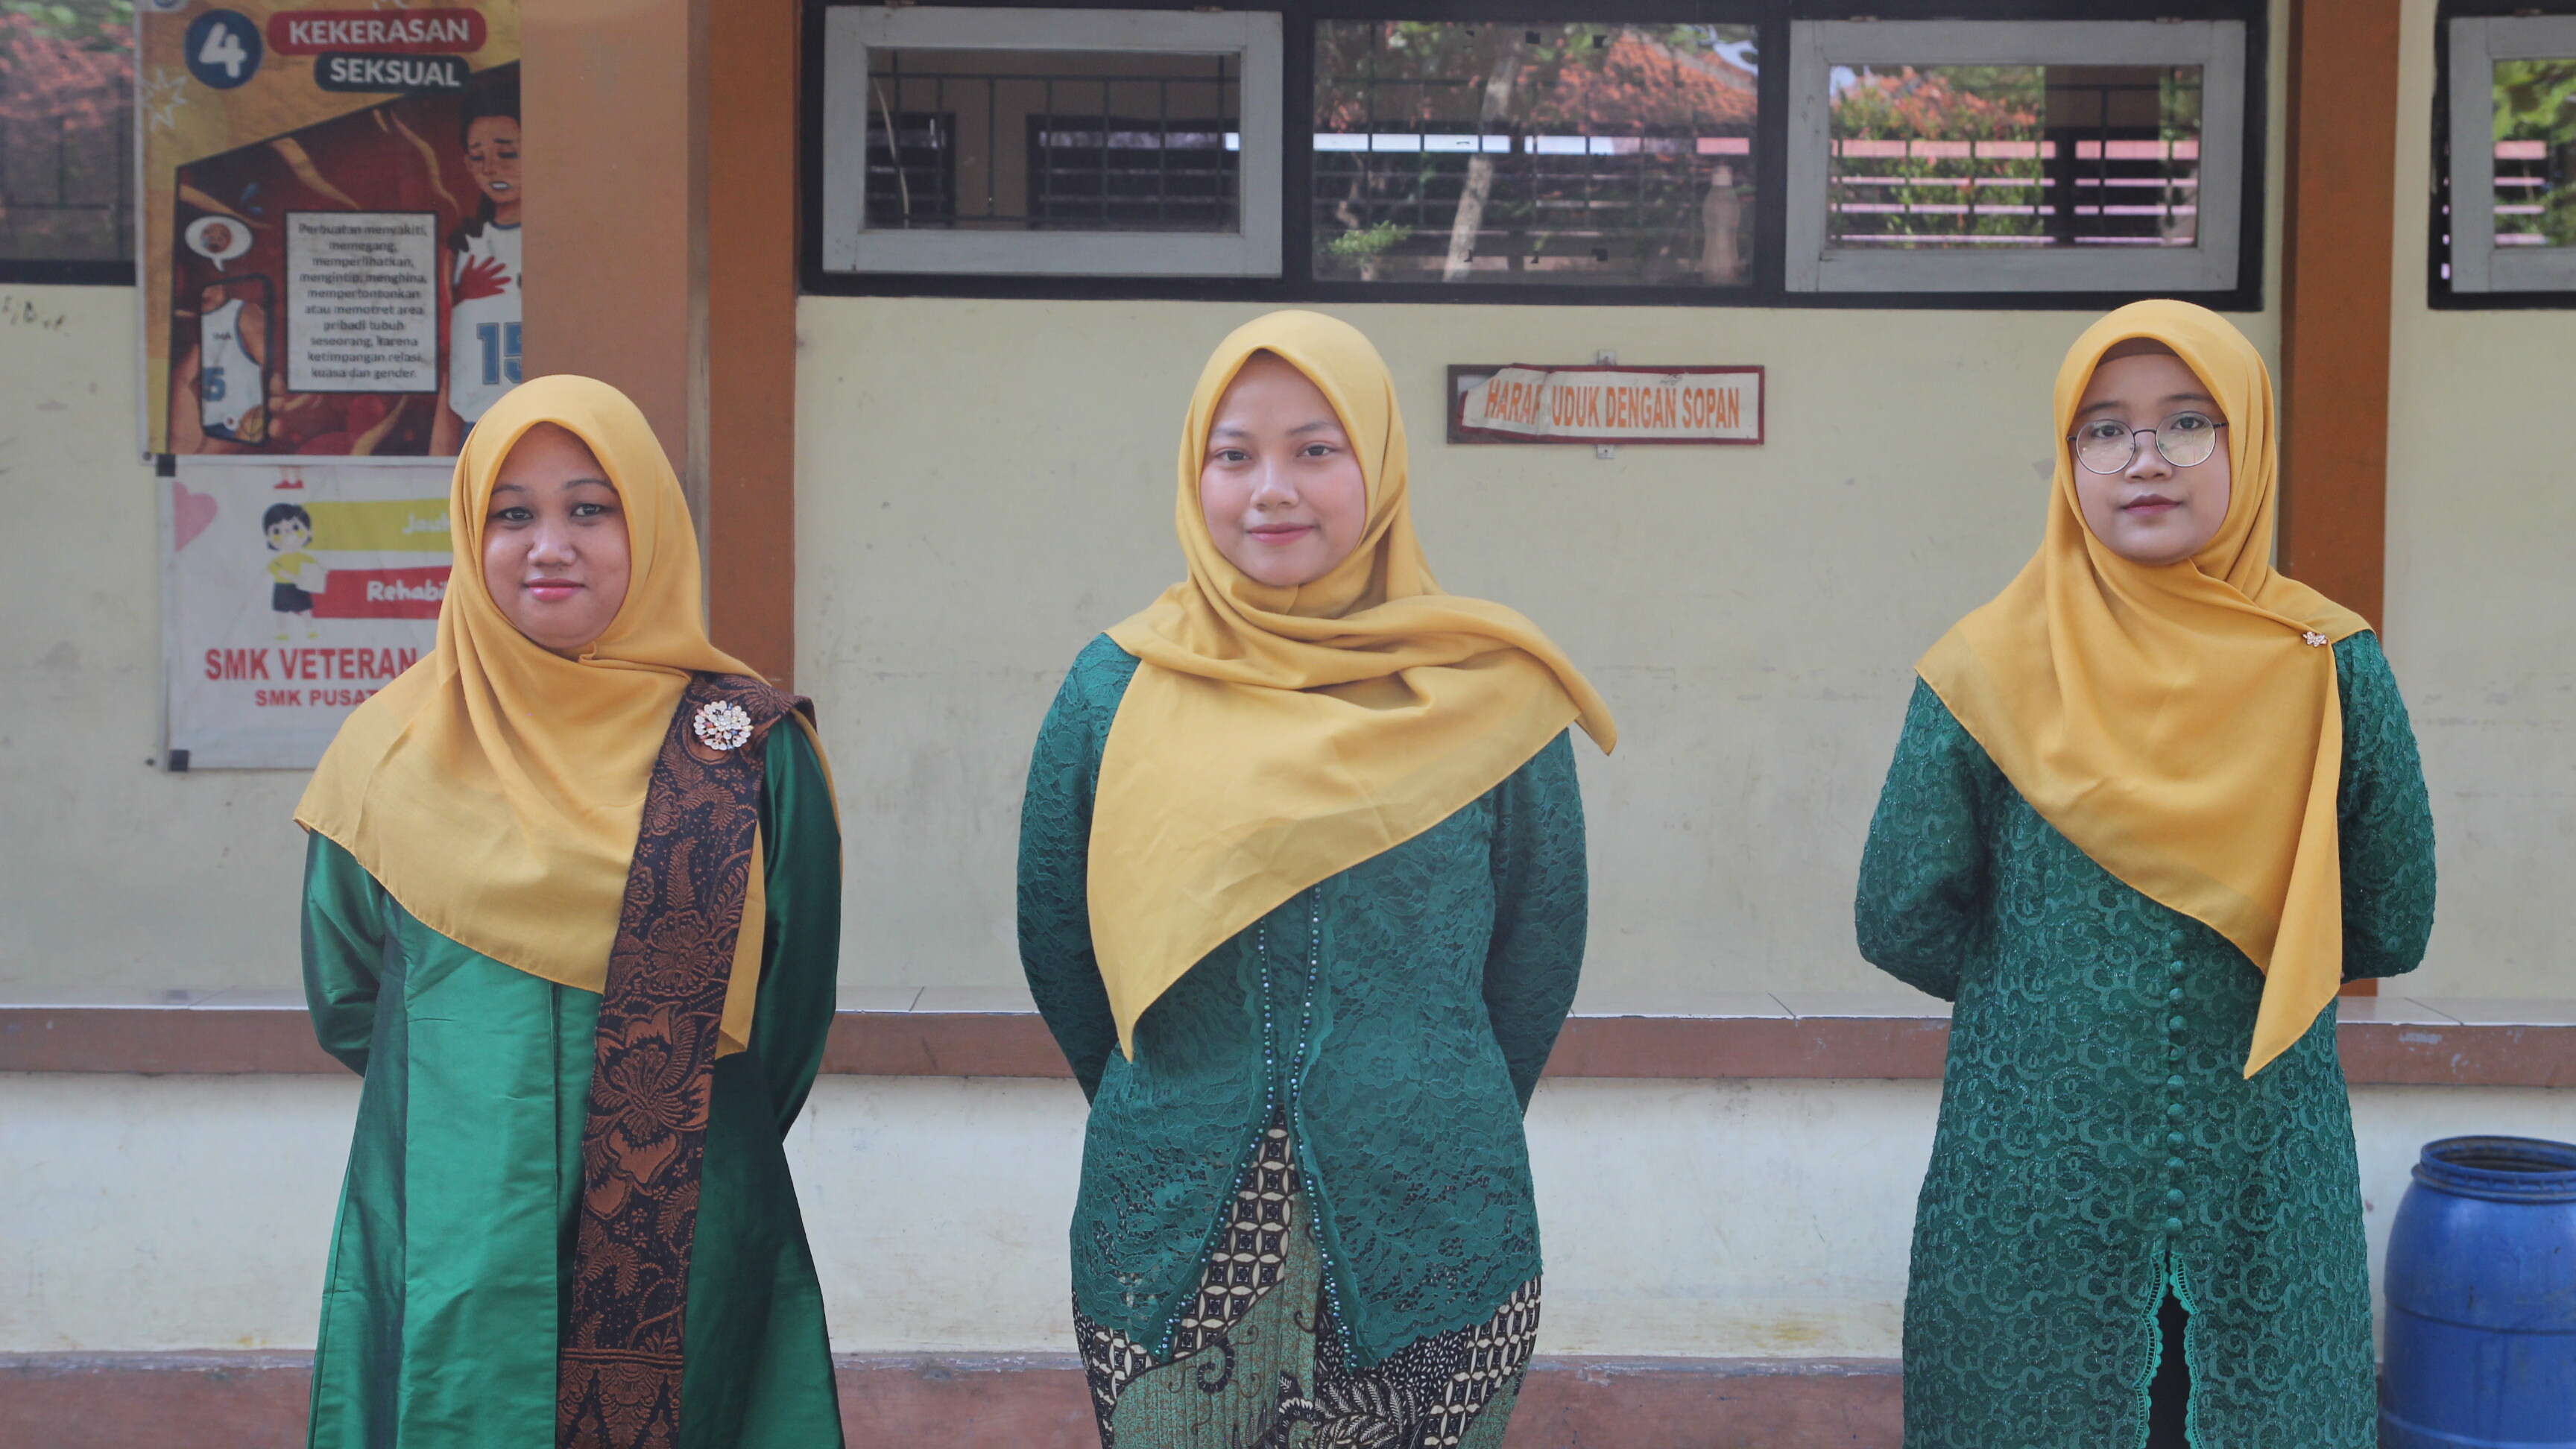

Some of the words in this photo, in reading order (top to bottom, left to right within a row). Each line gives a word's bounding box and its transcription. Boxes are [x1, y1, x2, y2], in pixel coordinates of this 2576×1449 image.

[289, 19, 470, 45] KEKERASAN
[198, 22, 247, 79] 4
[329, 57, 461, 86] SEKSUAL
[299, 223, 362, 235] Perbuatan
[307, 288, 420, 300] mempertontonkan
[305, 304, 330, 315] atau
[334, 304, 394, 315] memotret
[323, 320, 365, 332] pribadi
[369, 320, 405, 330] tubuh
[376, 335, 417, 347] karena
[307, 351, 385, 364] ketimpangan
[312, 367, 347, 377] kuasa
[349, 367, 370, 377] dan
[1552, 385, 1600, 428] UDUK
[1606, 385, 1677, 429] DENGAN
[1682, 386, 1740, 429] SOPAN
[367, 579, 449, 602] Rehabi
[205, 648, 270, 681] SMK
[279, 647, 417, 680] VETERAN
[255, 689, 302, 707] SMK
